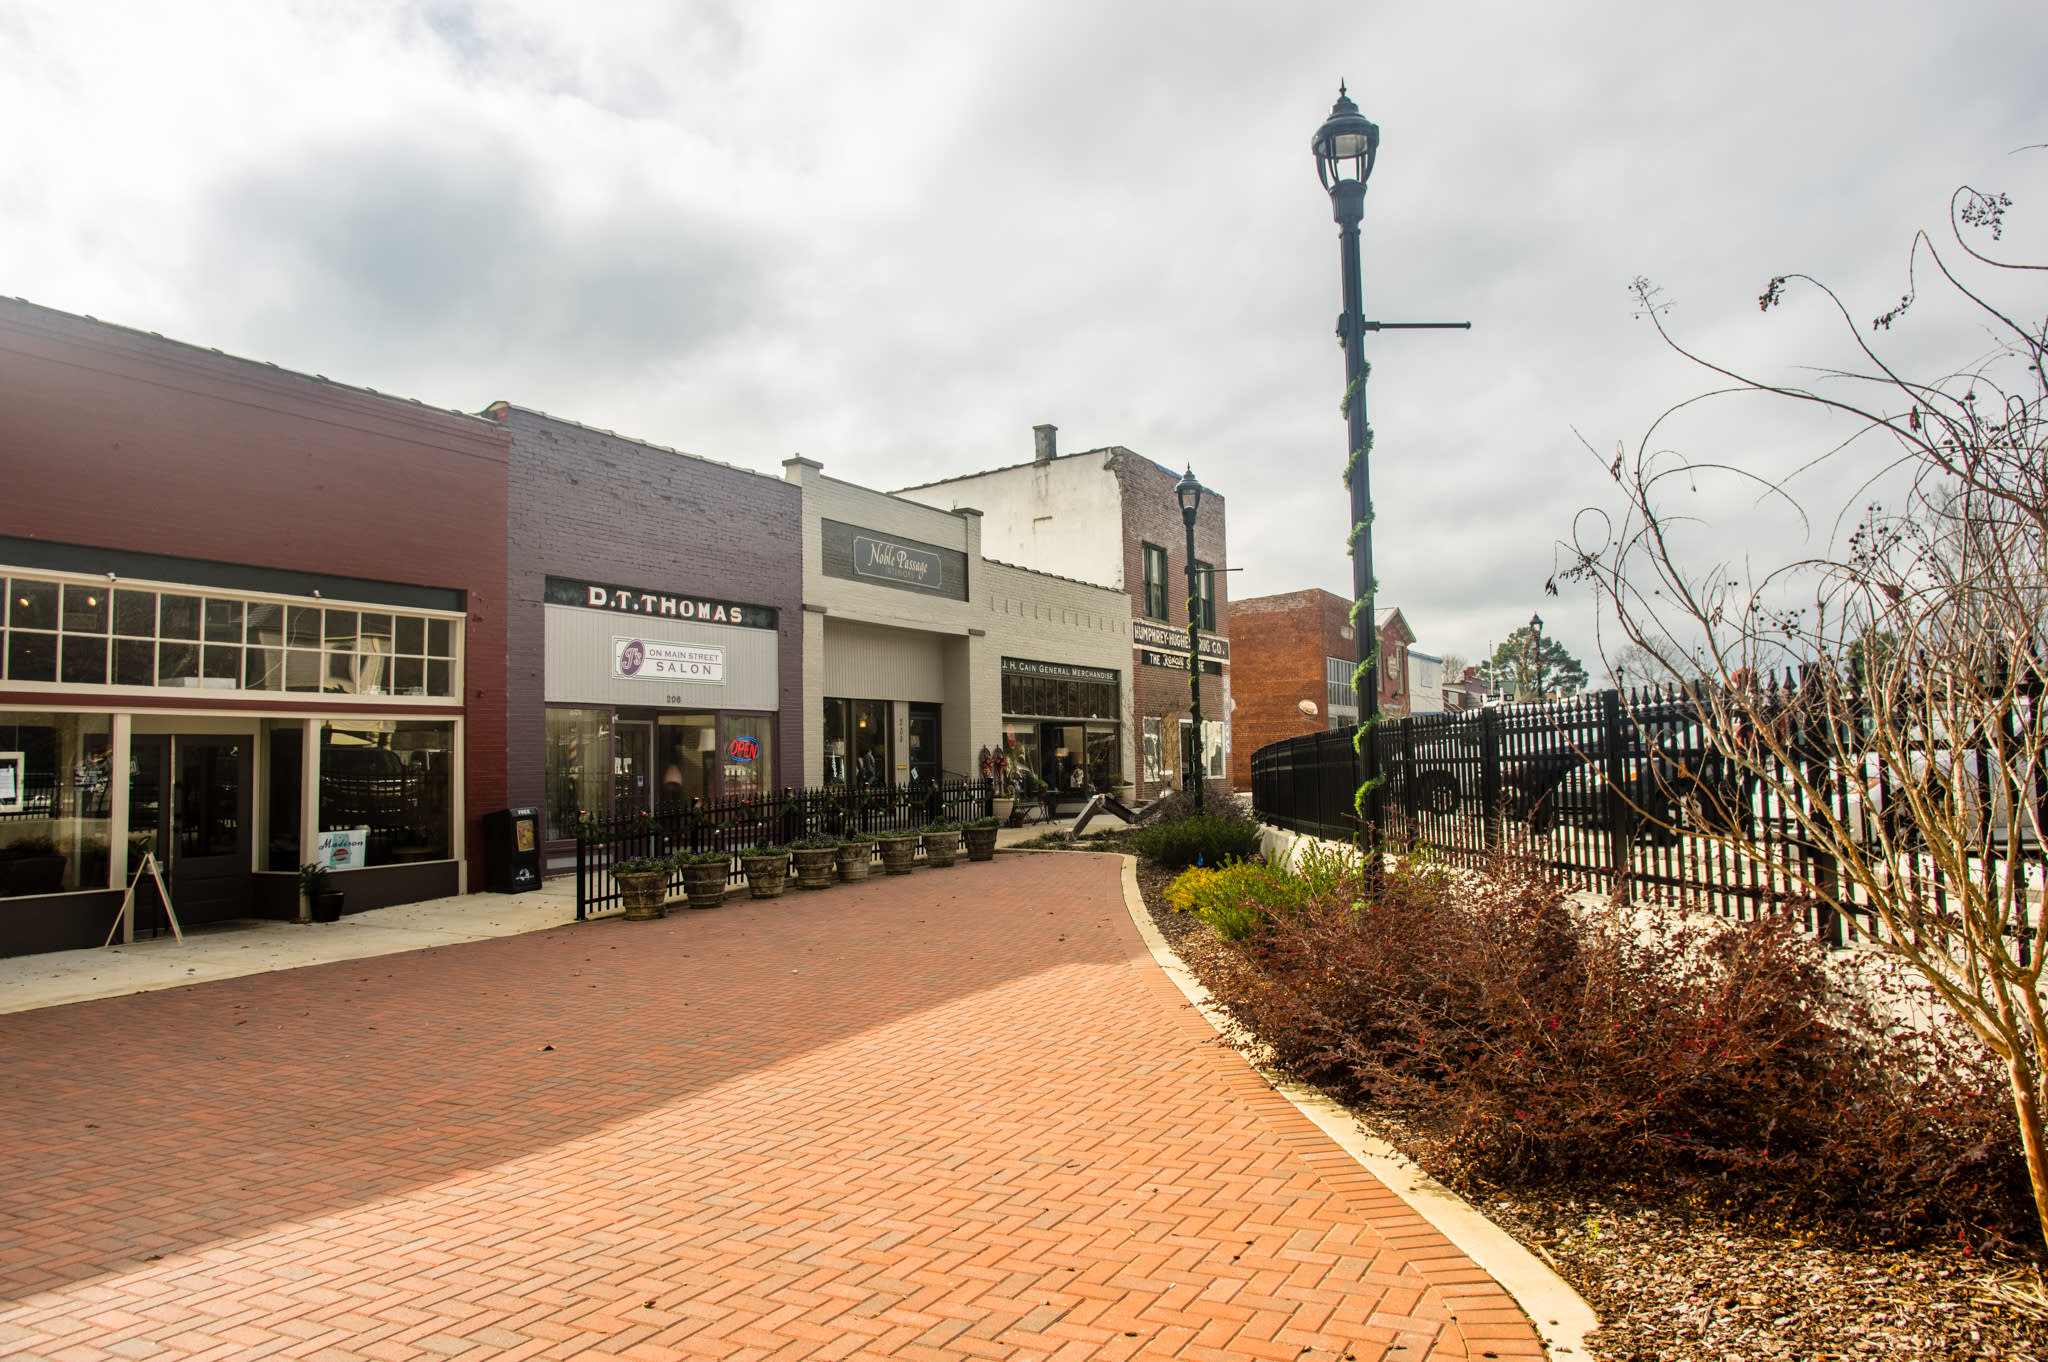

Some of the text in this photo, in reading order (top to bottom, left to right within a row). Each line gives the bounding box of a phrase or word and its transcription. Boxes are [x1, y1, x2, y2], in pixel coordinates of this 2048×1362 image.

[867, 543, 928, 580] Noble Passage
[649, 648, 719, 662] ON MAIN STREET
[1212, 641, 1225, 655] CO.
[1149, 652, 1161, 665] THE
[656, 661, 712, 675] SALON
[1019, 662, 1037, 672] CAIN
[1039, 664, 1070, 676] GENERAL
[1072, 668, 1114, 680] MERCHANDISE
[730, 739, 758, 760] OPEN
[318, 838, 364, 850] Madison
